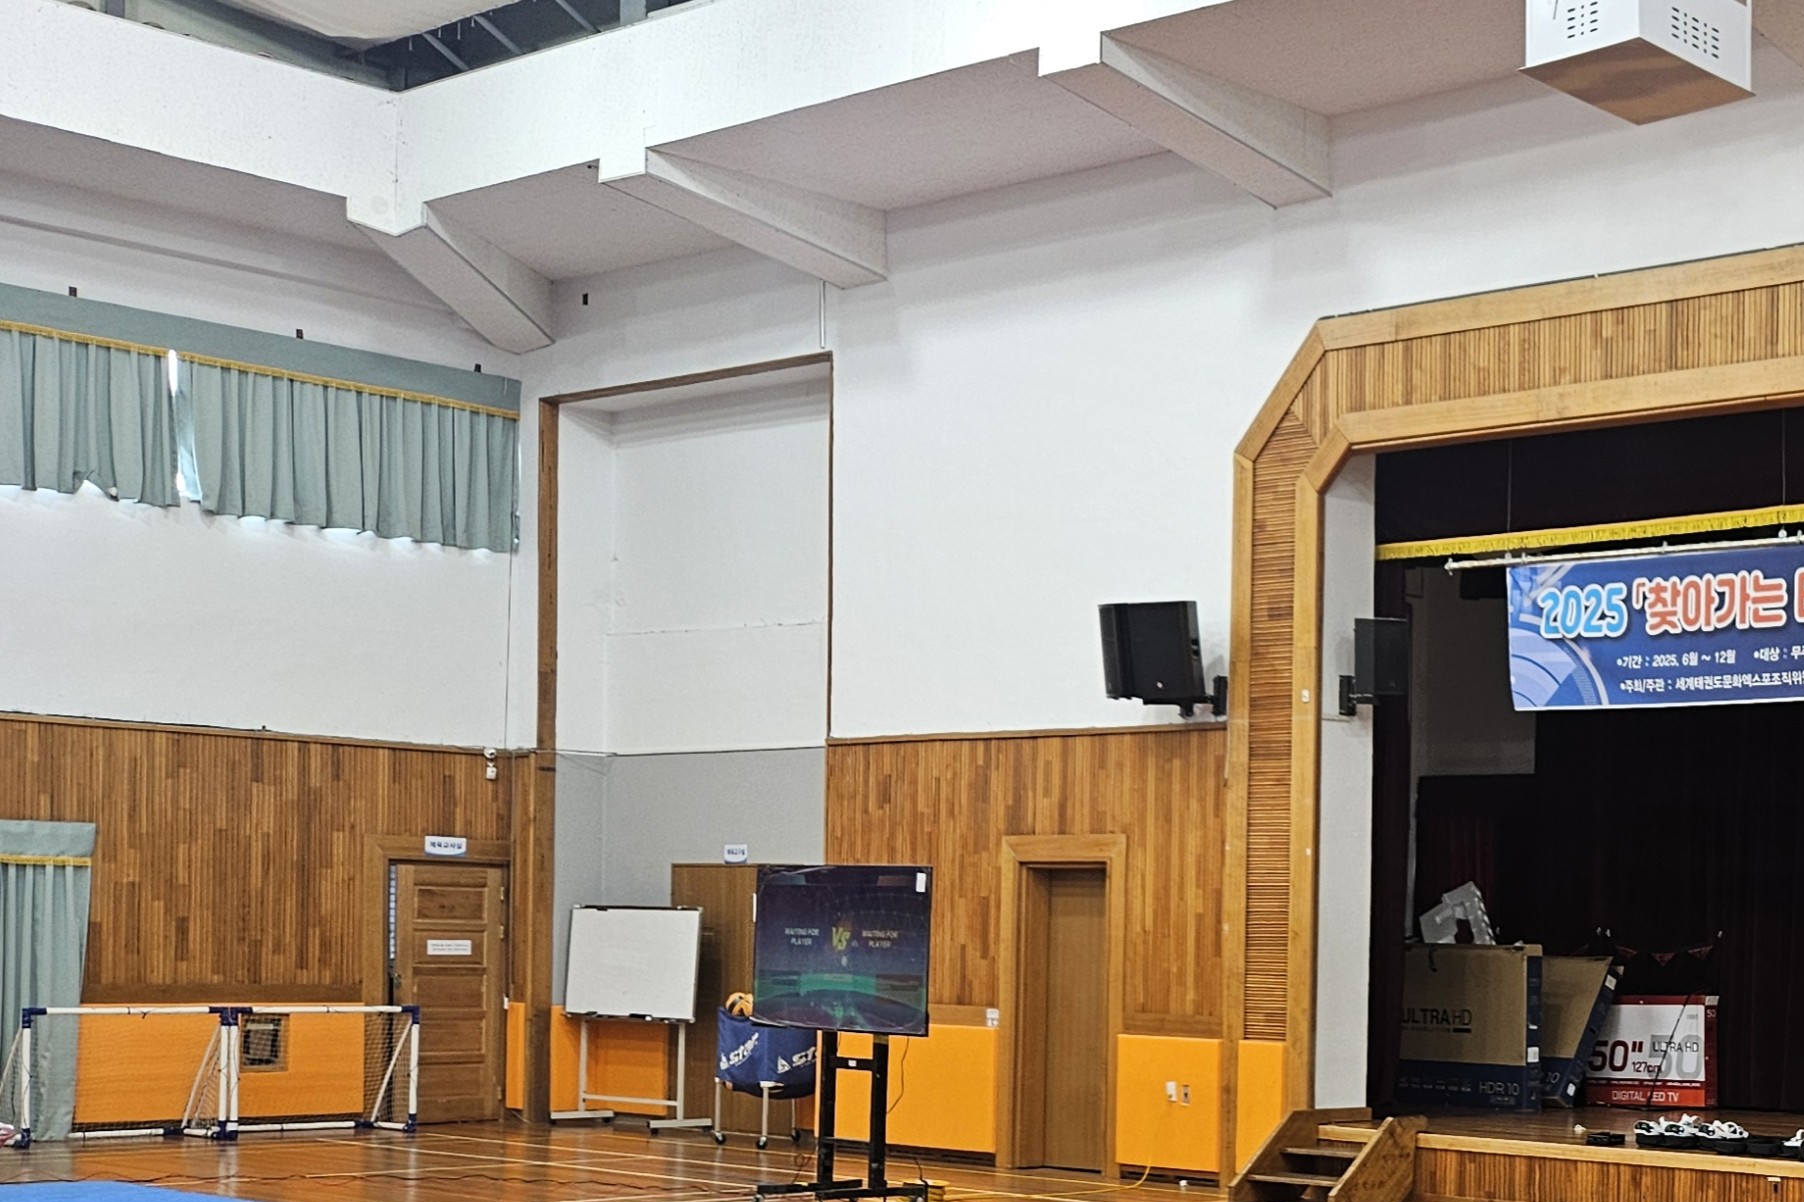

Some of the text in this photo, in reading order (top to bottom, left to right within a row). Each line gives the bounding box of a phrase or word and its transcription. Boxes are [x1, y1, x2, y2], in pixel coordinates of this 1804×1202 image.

[1539, 583, 1628, 638] 2025
[1622, 655, 1643, 668] 기간
[1682, 651, 1698, 666] 6월
[1715, 649, 1736, 664] 12월
[1760, 646, 1780, 661] 대상
[832, 926, 851, 951] VS
[1684, 1041, 1699, 1052] HD
[1612, 1090, 1646, 1101] DIGITAL
[1667, 1091, 1680, 1103] TV
